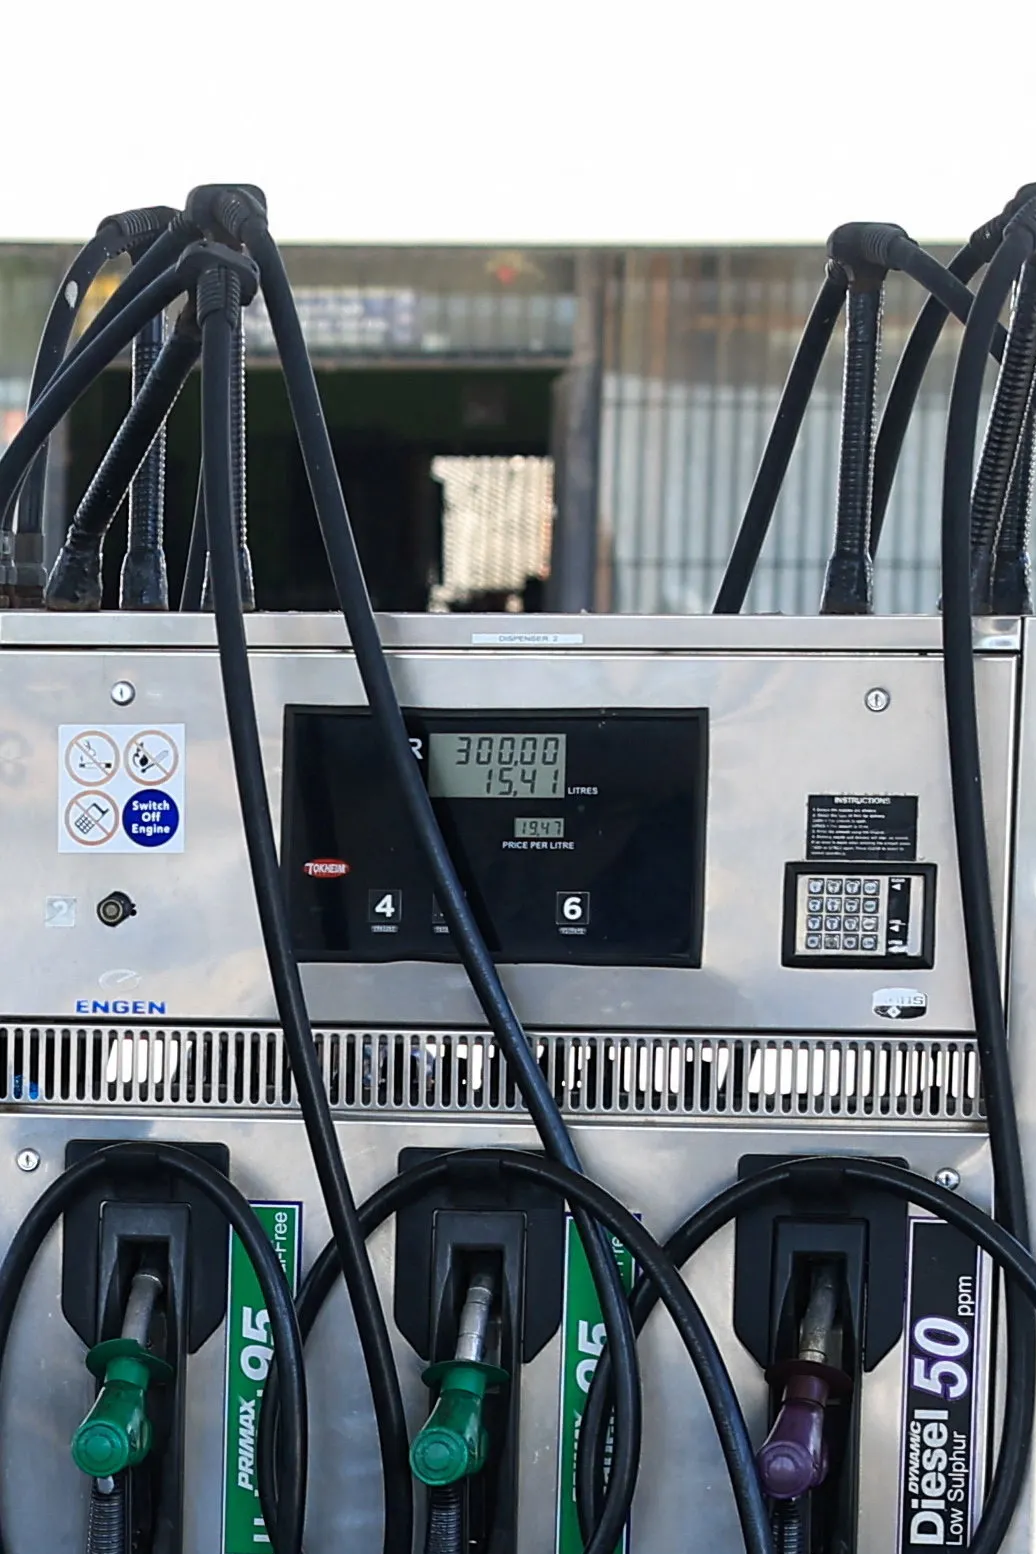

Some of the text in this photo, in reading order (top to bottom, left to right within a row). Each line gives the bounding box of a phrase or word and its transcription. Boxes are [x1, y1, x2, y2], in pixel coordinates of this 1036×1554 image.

[456, 737, 559, 767] 300,00
[485, 769, 598, 797] 15,41 LITRES
[132, 800, 170, 811] Switch
[834, 797, 891, 805] INSTRUCTIONS
[141, 811, 161, 822] Off
[131, 824, 170, 836] Engine
[502, 841, 575, 850] PRICE PER LITRE
[304, 863, 346, 875] TOKHEIM
[375, 894, 582, 920] 4 6
[76, 1000, 166, 1014] ENGEN
[910, 1275, 975, 1545] Diesel 50 ppm
[238, 1396, 256, 1491] PRIMAX
[908, 1421, 922, 1494] DYNAMIC
[946, 1431, 969, 1546] Low Sulphur
